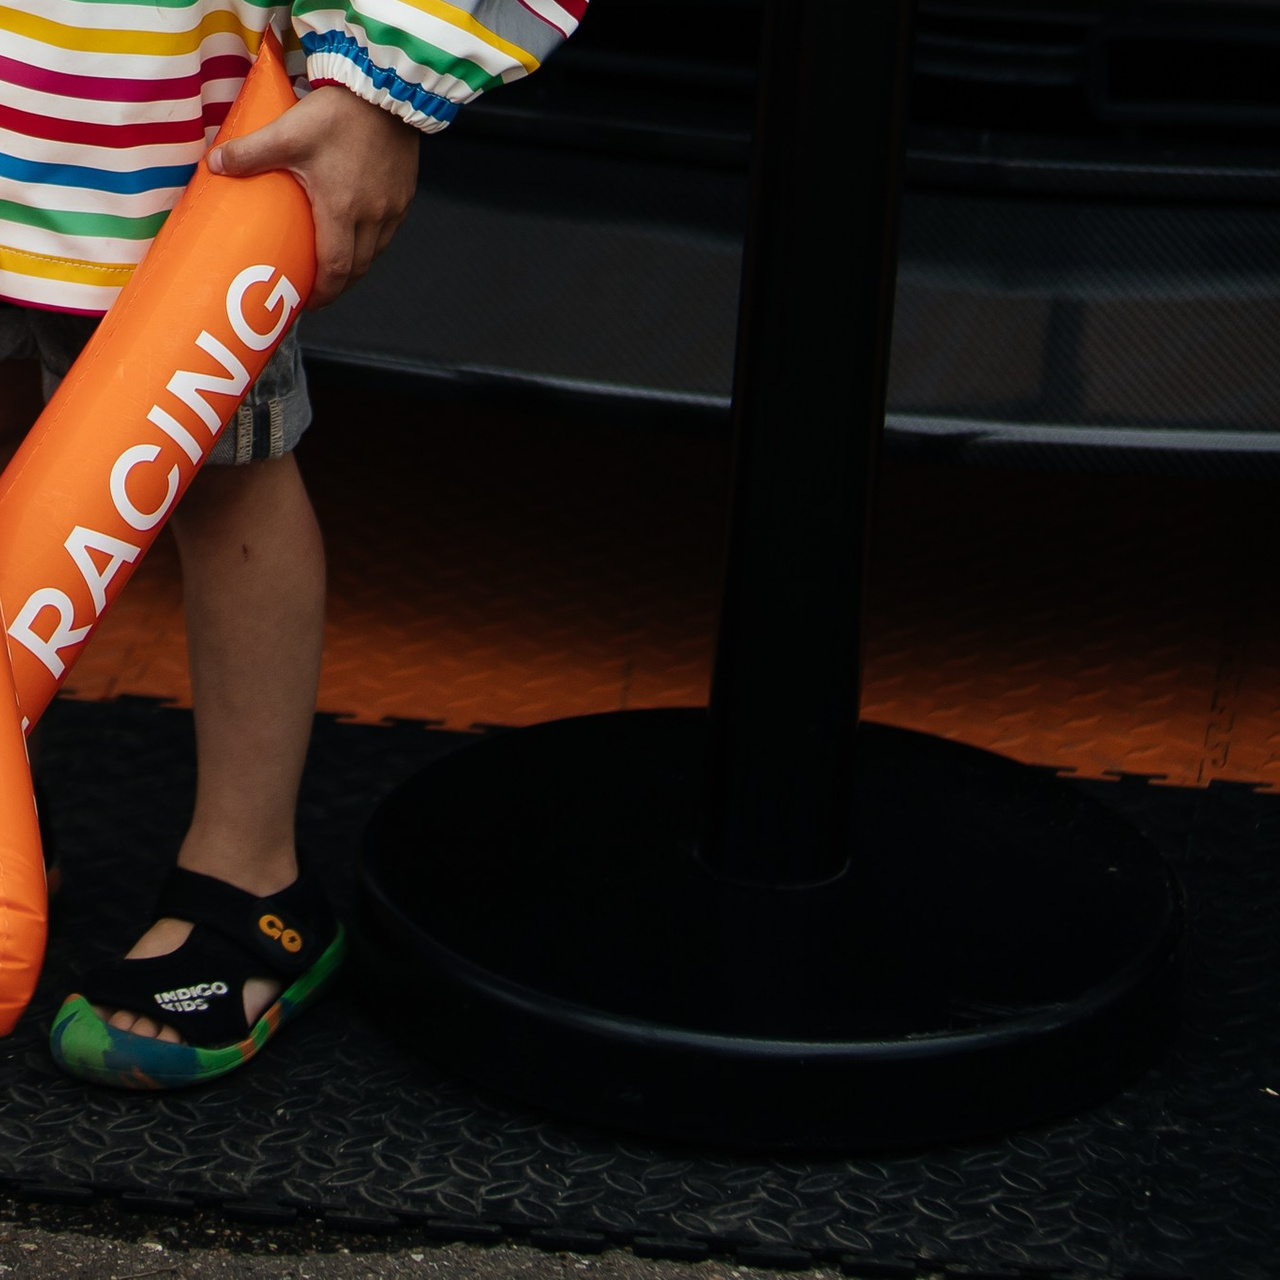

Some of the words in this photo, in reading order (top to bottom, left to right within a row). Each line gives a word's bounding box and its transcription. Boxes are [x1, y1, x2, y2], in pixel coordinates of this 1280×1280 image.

[7, 265, 301, 680] RACING
[259, 914, 303, 953] GO
[154, 981, 228, 1004] INDIGO
[161, 998, 209, 1012] KIDS
